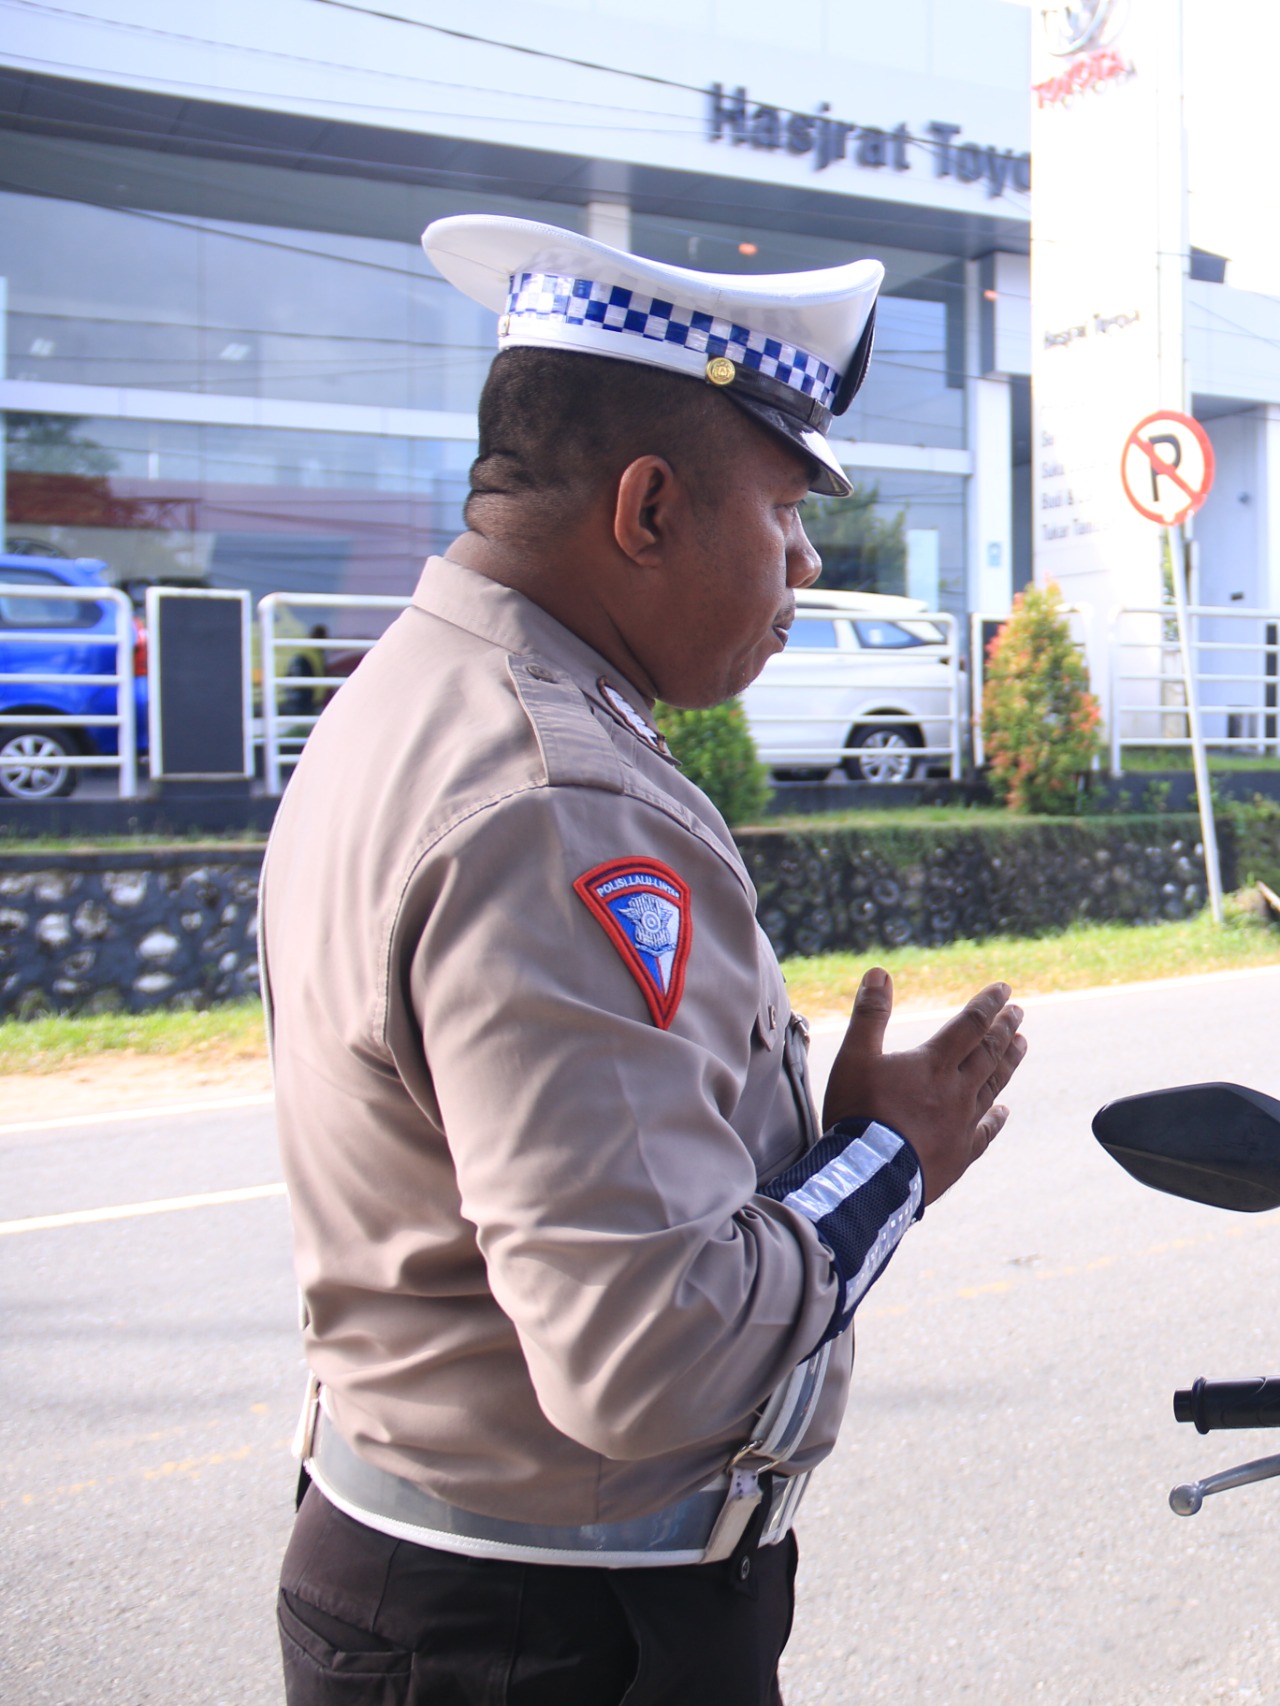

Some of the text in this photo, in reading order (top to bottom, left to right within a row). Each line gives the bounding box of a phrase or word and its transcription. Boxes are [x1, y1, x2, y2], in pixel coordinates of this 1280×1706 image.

[708, 81, 911, 173] Hasjrat
[1148, 433, 1182, 502] P
[596, 876, 628, 898] POLISI
